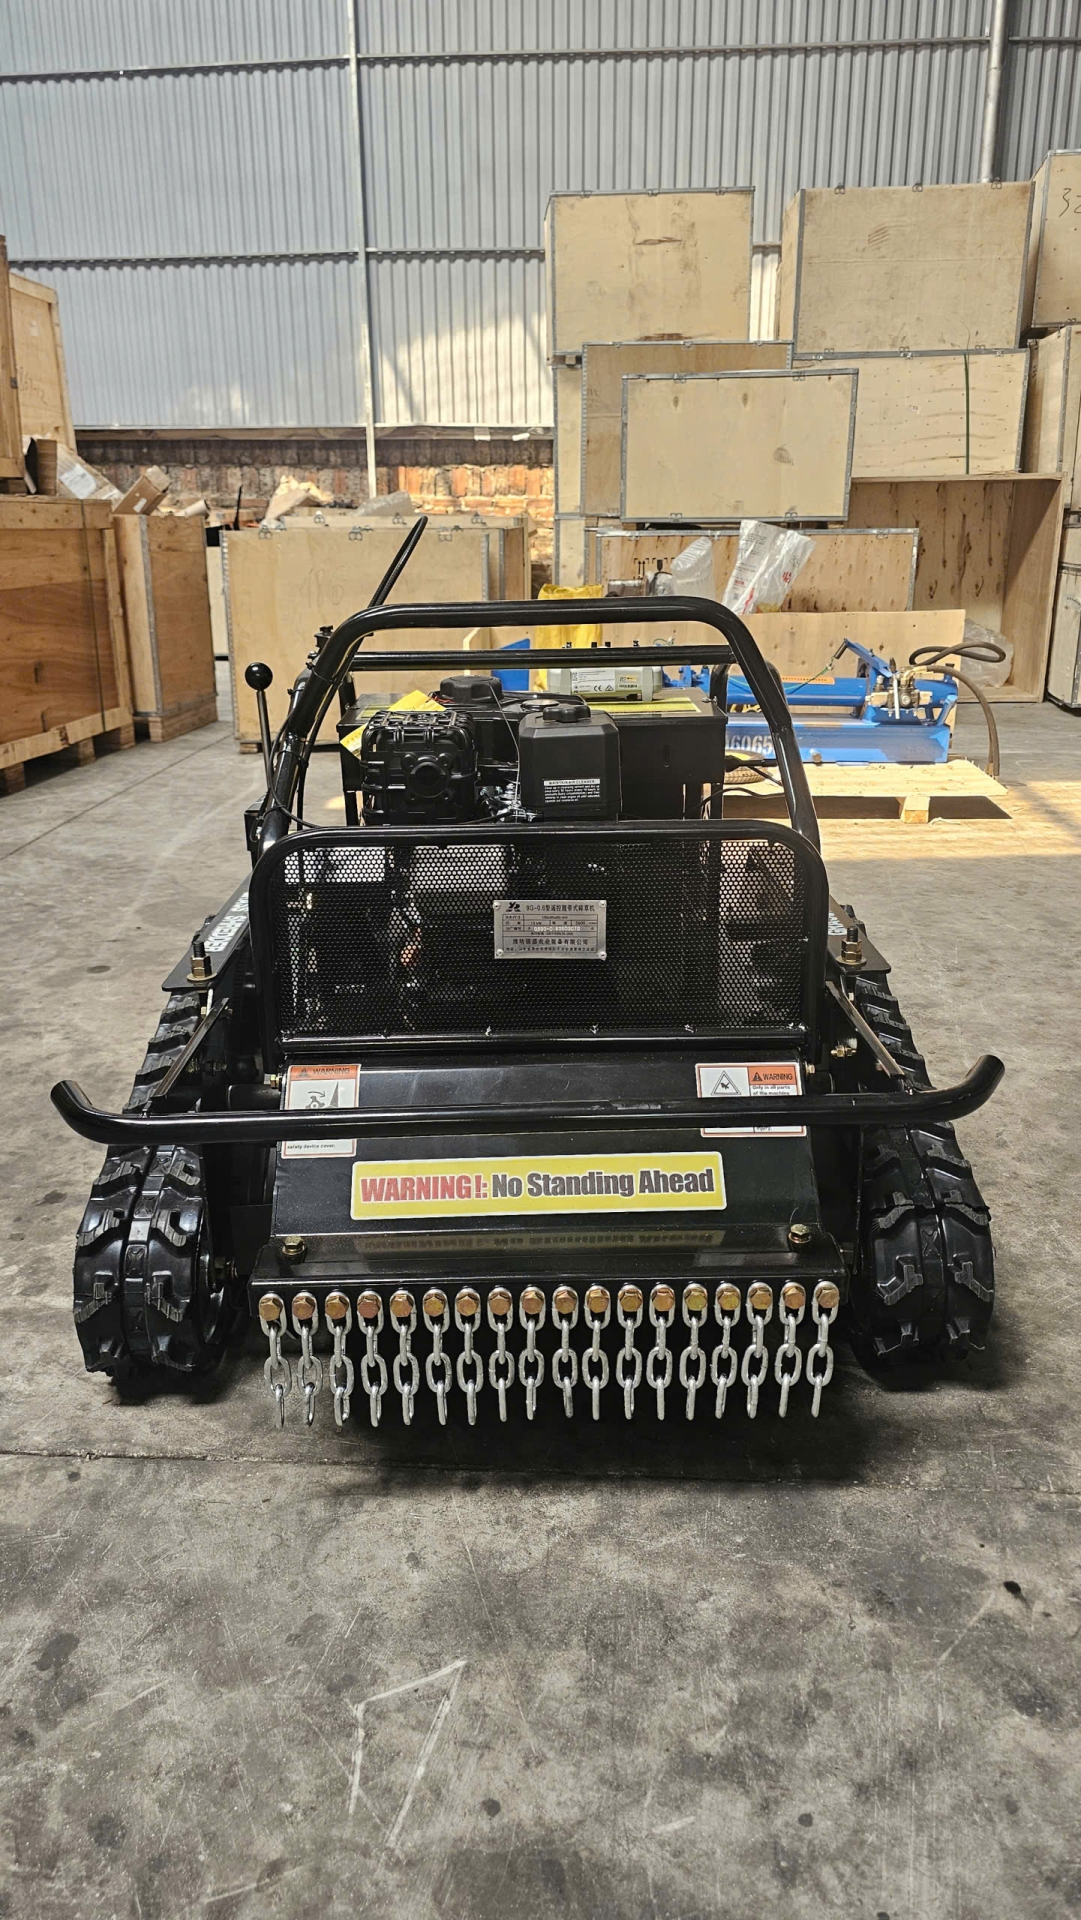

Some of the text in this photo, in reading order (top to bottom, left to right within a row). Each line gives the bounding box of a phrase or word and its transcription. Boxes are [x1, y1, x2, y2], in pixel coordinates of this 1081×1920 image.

[312, 1067, 350, 1075] WARNING
[763, 1073, 793, 1081] WARNING
[492, 1173, 523, 1198] No
[527, 1171, 634, 1197] Standing
[639, 1169, 714, 1194] Ahead
